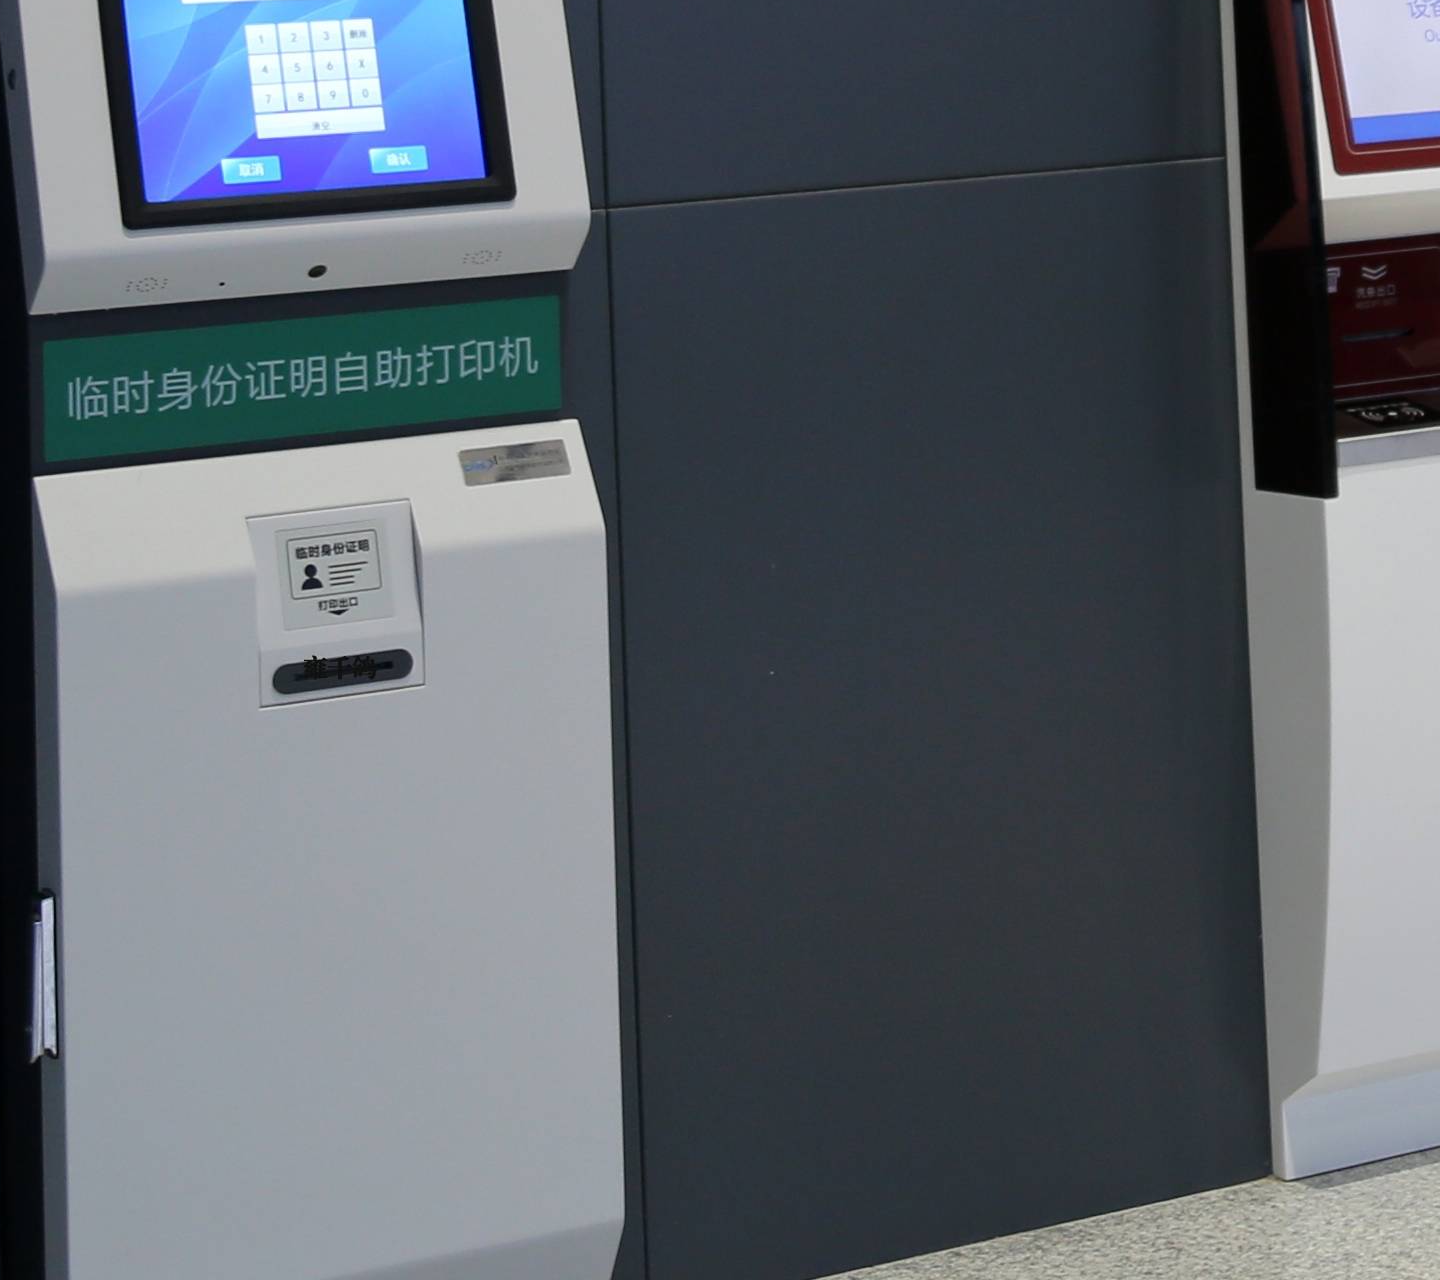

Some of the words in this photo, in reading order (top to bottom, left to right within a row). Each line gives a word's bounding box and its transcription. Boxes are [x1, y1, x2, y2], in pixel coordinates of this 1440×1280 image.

[67, 336, 539, 421] 临时身份证明自助打印机
[295, 539, 370, 560] 临时身份证明
[318, 597, 359, 611] 打印出口
